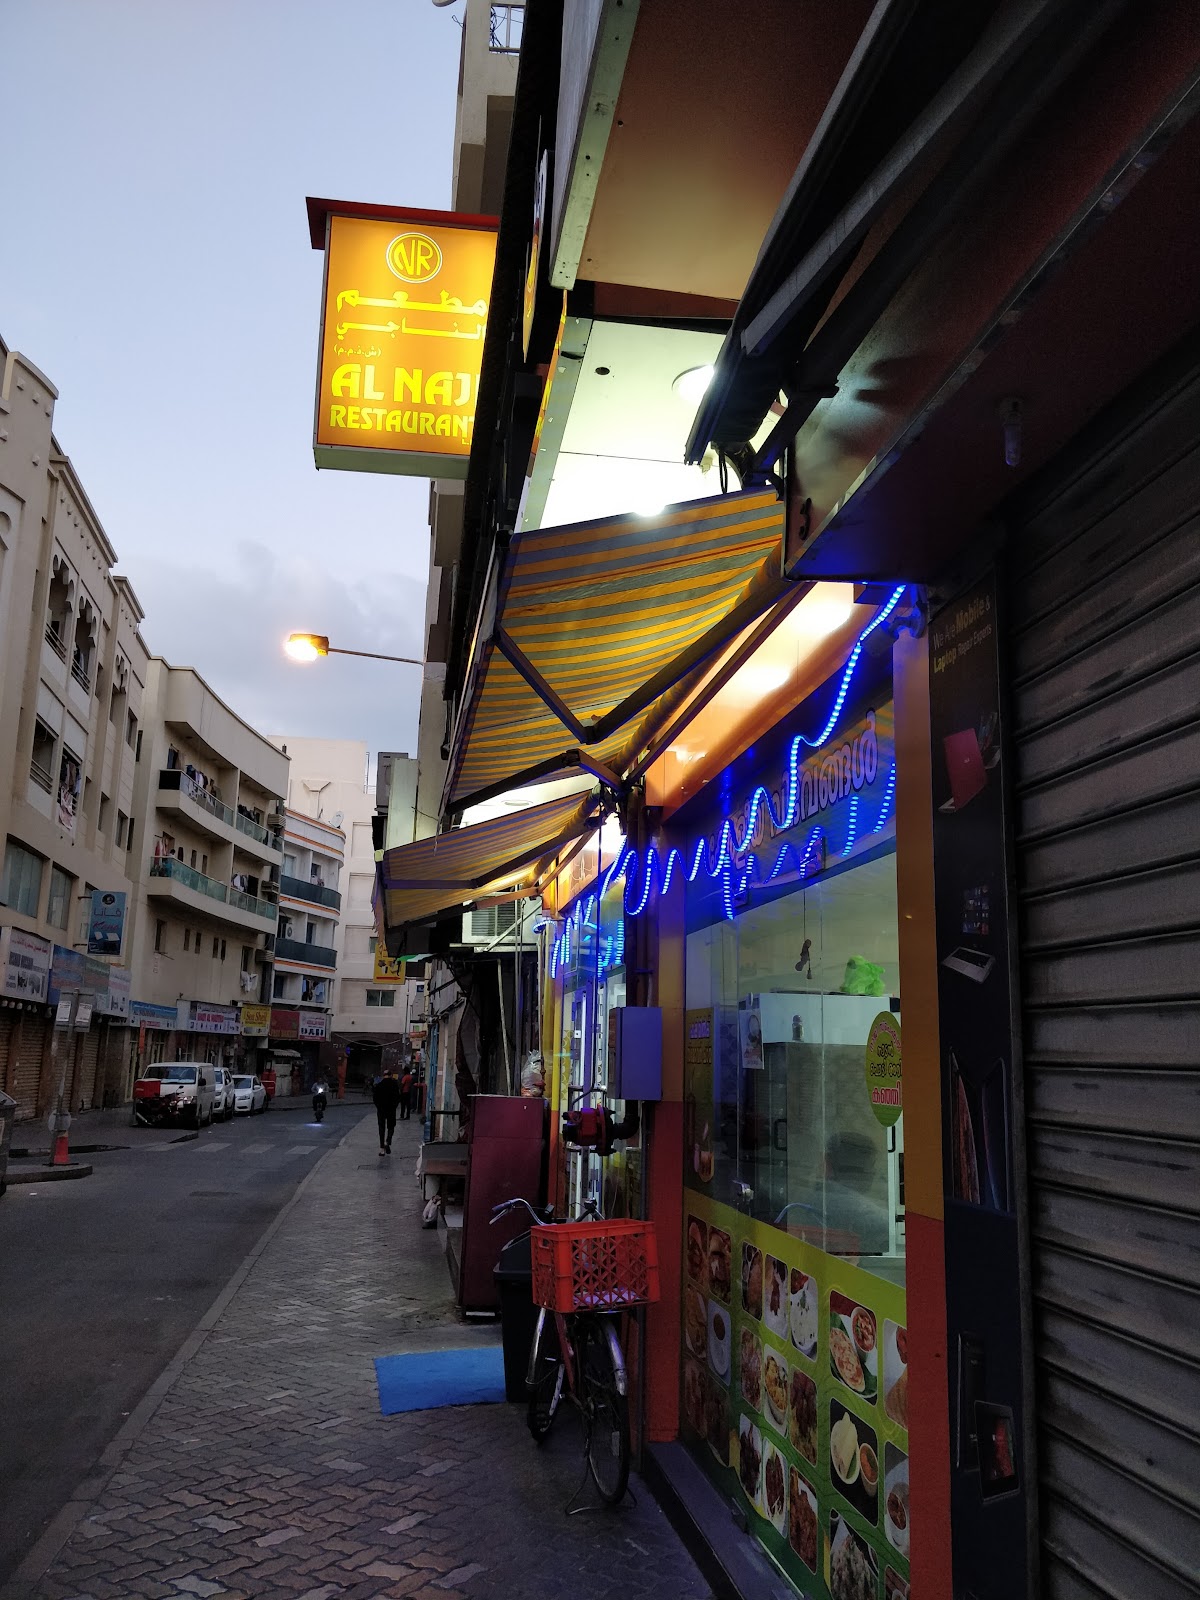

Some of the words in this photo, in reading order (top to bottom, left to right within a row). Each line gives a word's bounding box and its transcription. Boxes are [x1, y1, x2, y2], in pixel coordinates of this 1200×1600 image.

[336, 289, 488, 317] مطعم
[331, 363, 385, 401] AL
[955, 597, 985, 634] Mobile
[933, 647, 957, 674] Laptop
[973, 623, 993, 646] Experts
